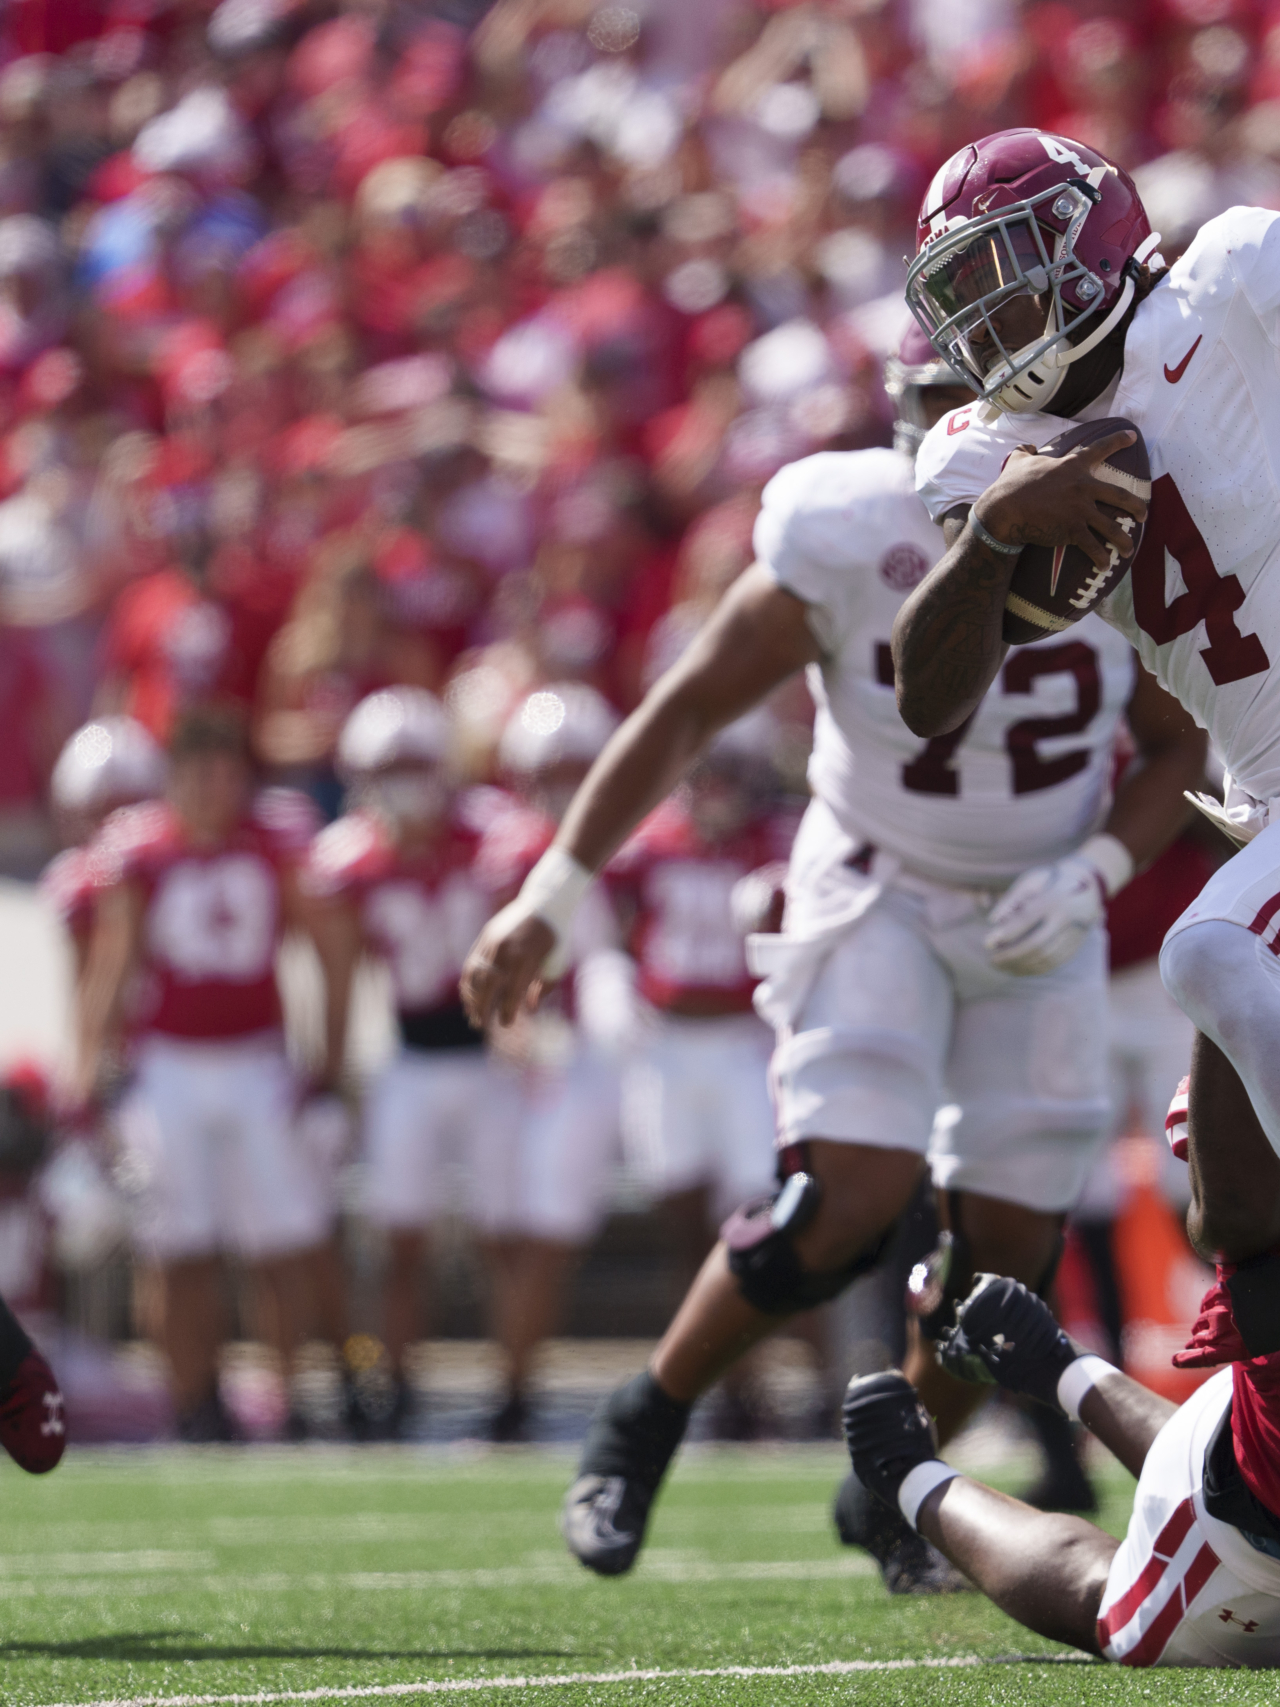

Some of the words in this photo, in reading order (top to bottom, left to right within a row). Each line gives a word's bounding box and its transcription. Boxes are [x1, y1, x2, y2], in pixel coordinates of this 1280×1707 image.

[1037, 136, 1092, 175] 4
[947, 408, 972, 436] C
[1131, 472, 1270, 686] 4
